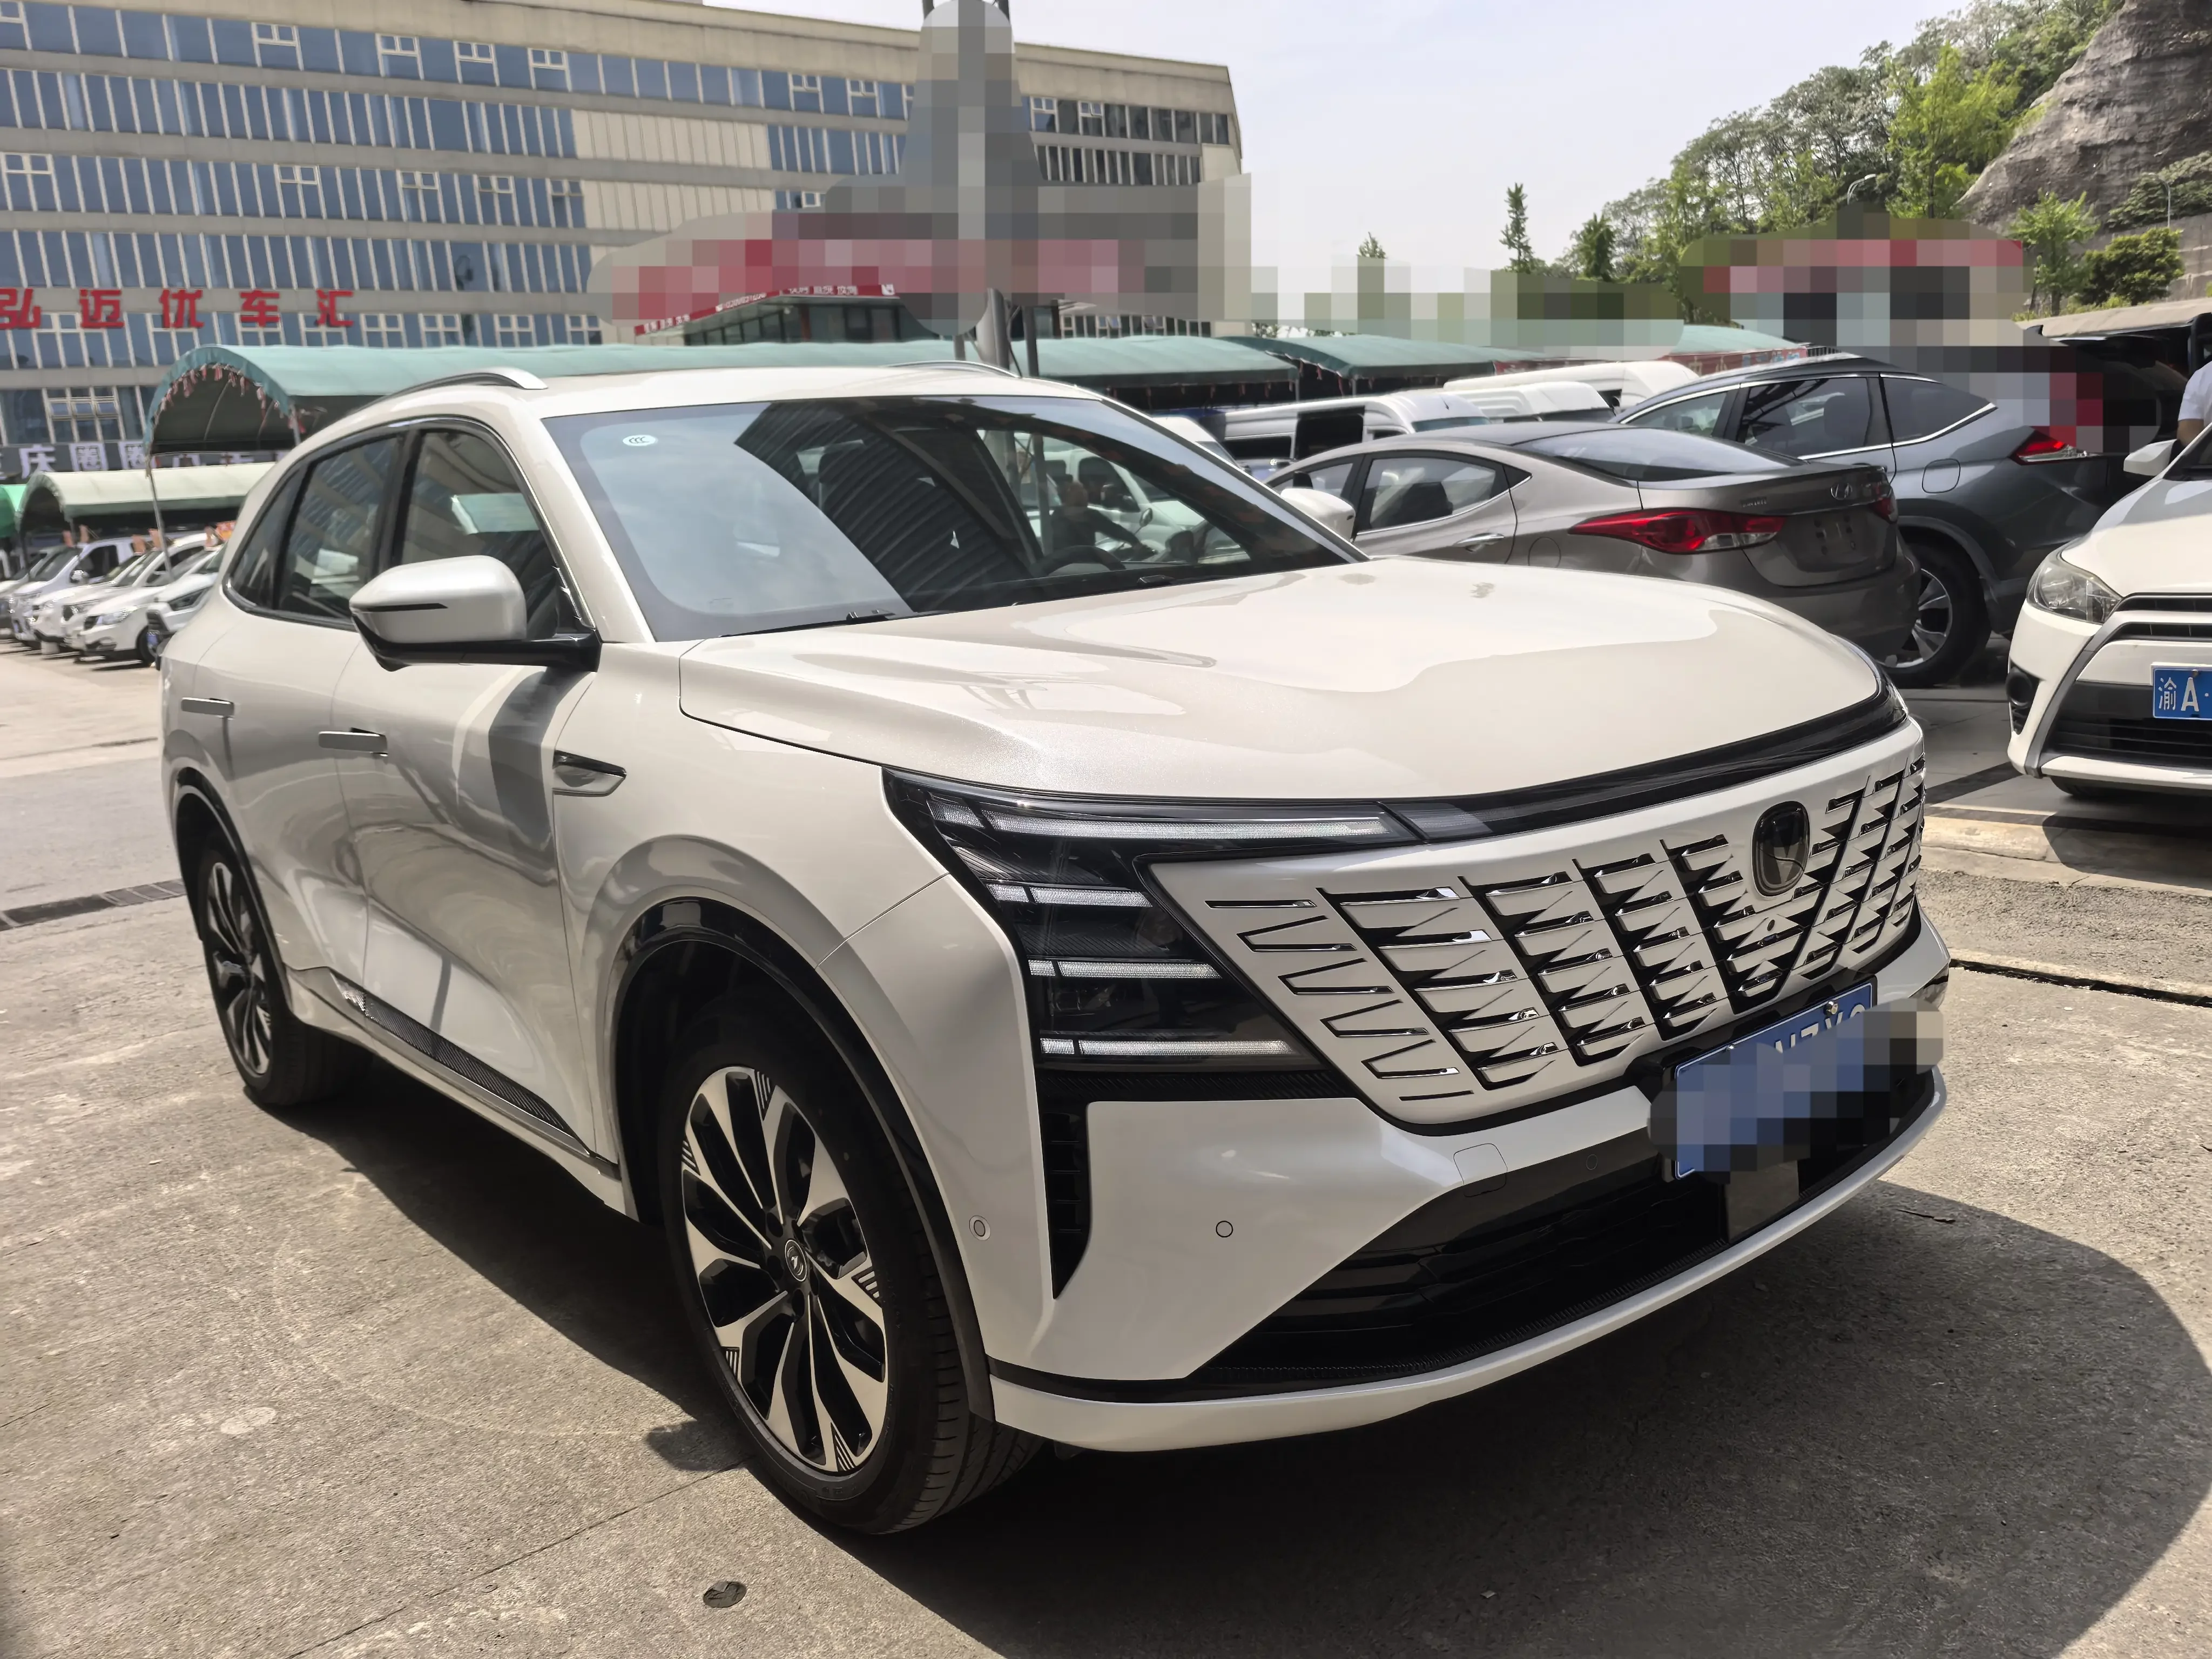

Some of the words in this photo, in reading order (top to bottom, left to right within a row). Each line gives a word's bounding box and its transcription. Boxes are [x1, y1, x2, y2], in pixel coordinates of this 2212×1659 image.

[0, 288, 354, 328] 弘迈优车汇
